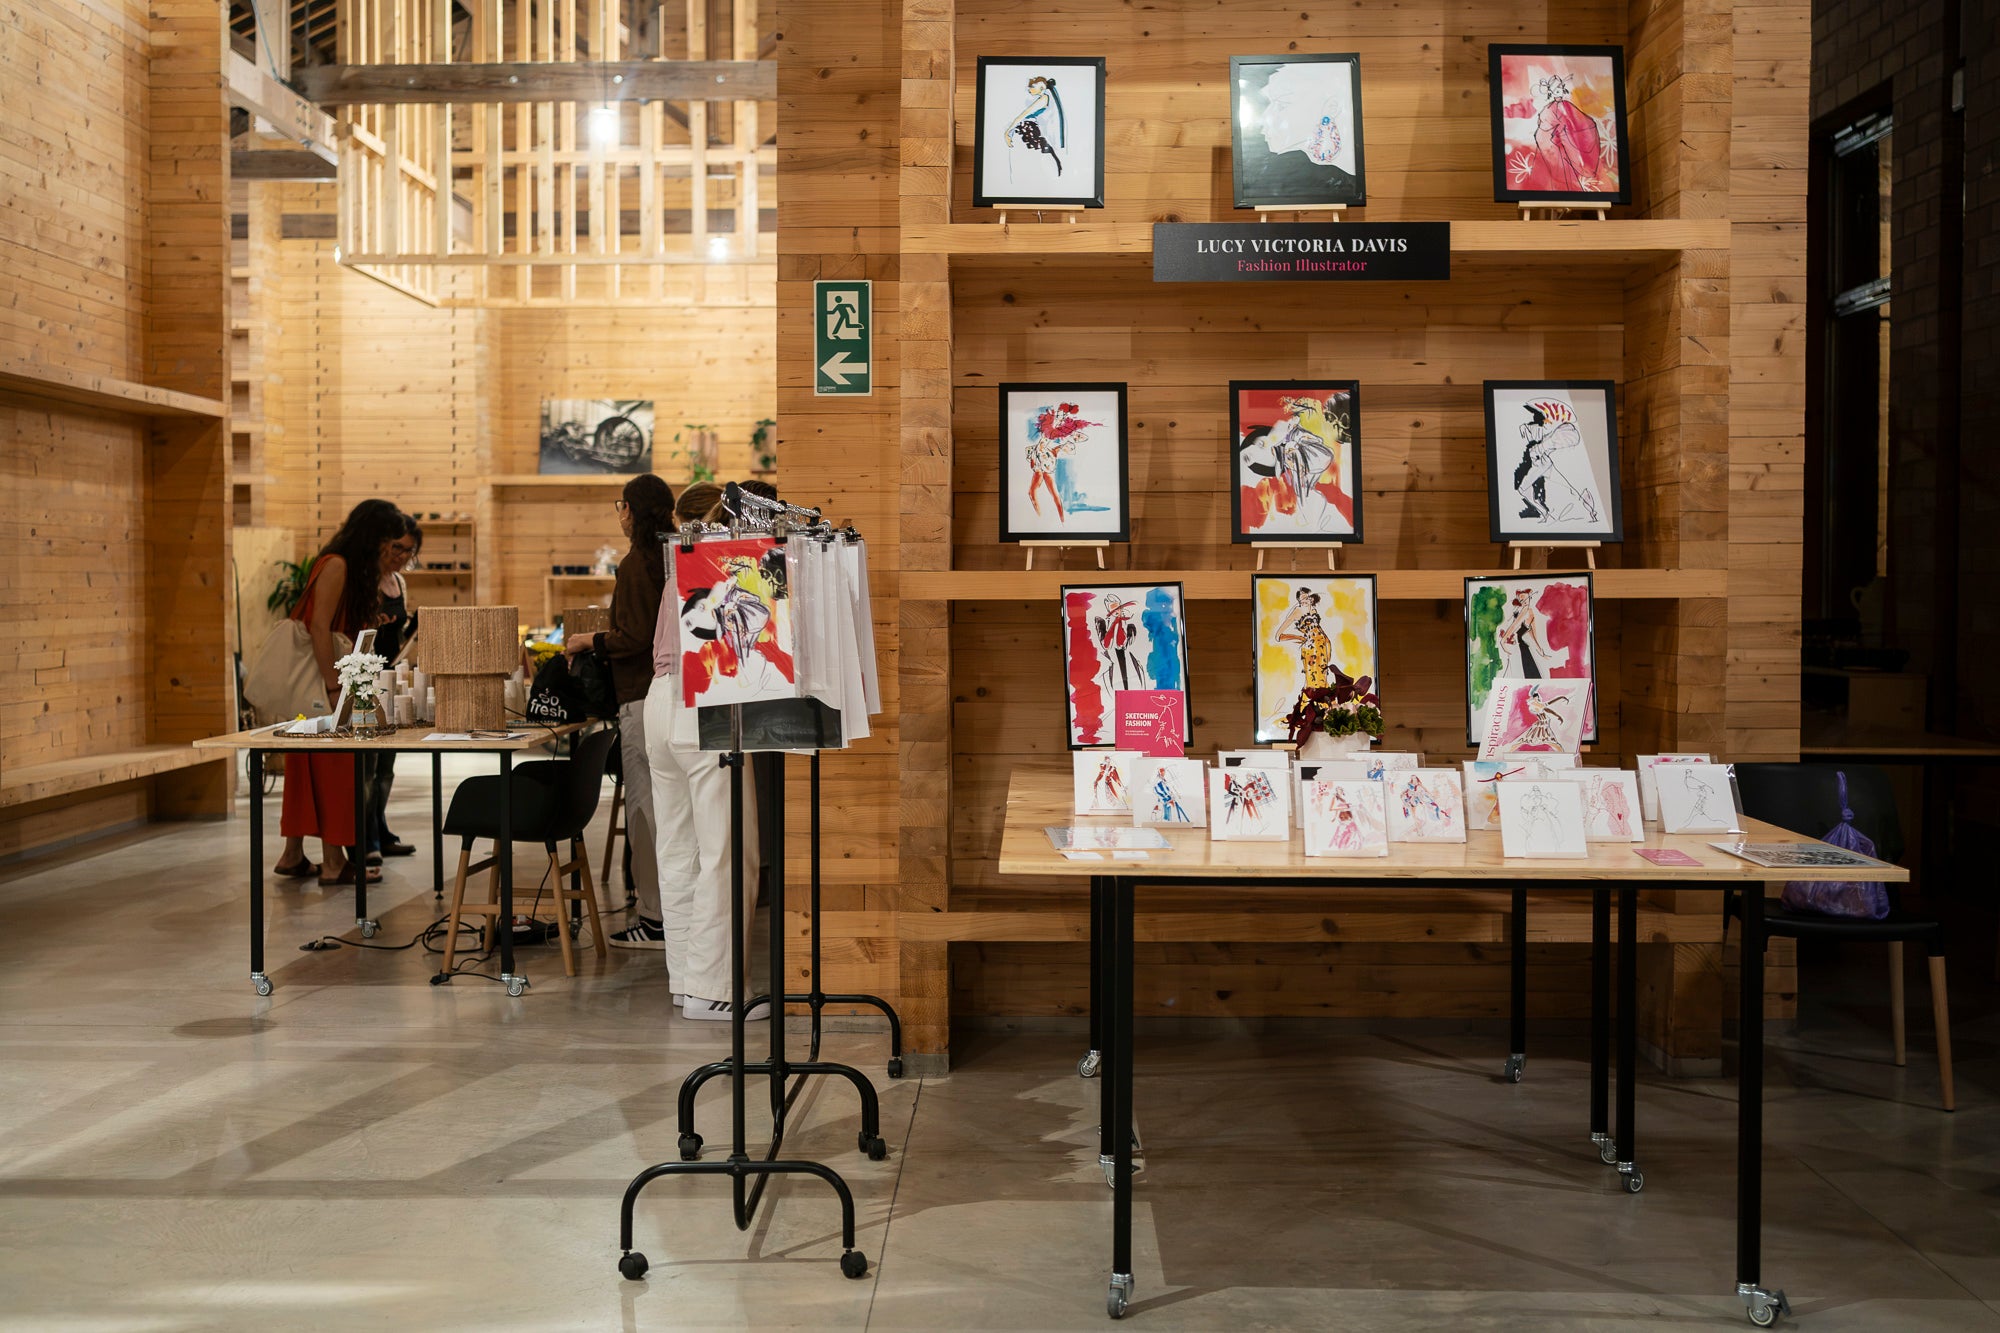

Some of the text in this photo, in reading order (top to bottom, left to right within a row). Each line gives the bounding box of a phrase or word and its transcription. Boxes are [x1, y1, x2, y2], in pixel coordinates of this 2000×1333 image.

[1197, 238, 1408, 254] LUCY VICTORIA DAVIS
[1237, 258, 1368, 272] Fashion Illustrator
[530, 698, 568, 720] fresh
[1125, 712, 1159, 720] SKETCHING
